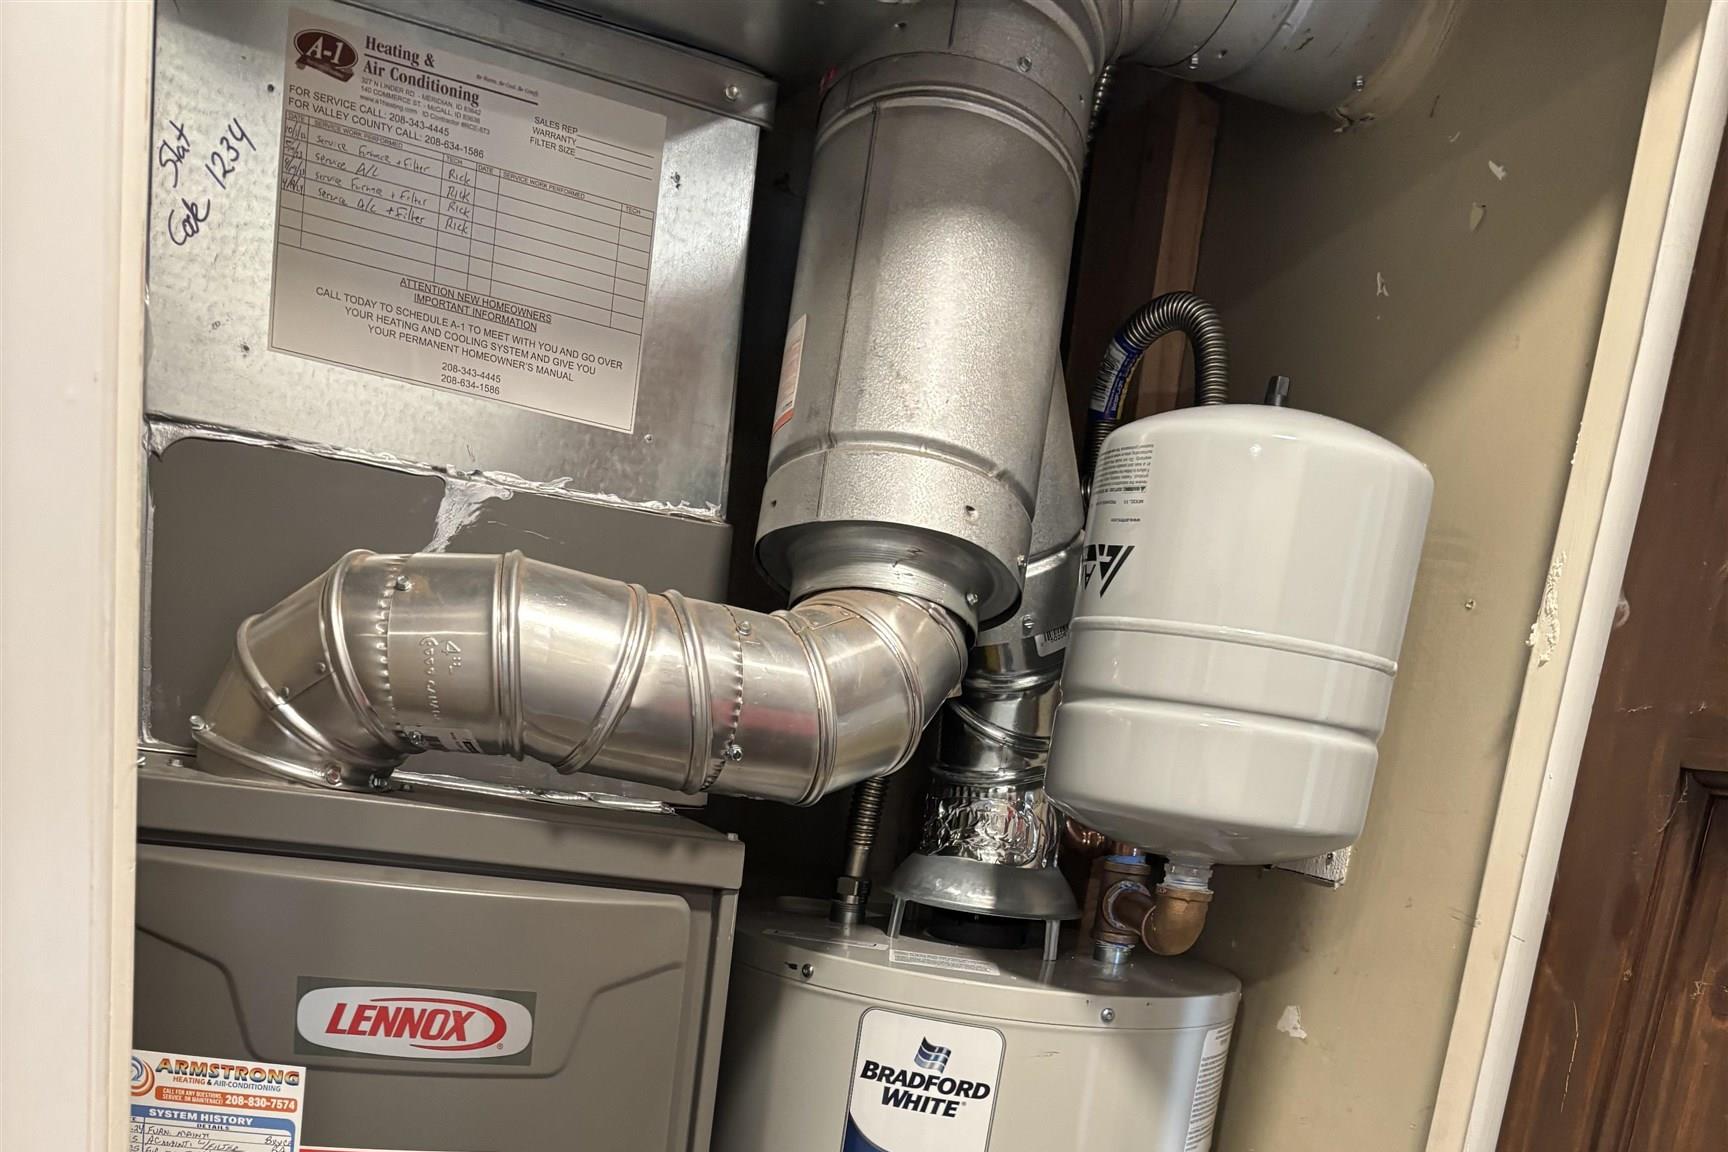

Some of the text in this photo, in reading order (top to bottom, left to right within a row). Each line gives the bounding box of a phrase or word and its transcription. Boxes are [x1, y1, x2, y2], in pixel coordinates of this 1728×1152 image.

[307, 36, 343, 65] A-1
[365, 35, 436, 68] Heating &
[363, 60, 385, 78] Air
[390, 67, 479, 107] Conditioning
[289, 84, 311, 97] FOR
[313, 91, 356, 111] SERVICE
[389, 112, 450, 137] 208-343-4445
[534, 116, 578, 134] SALES REP
[288, 97, 310, 111] FOR
[312, 103, 350, 121] VALLEY
[351, 115, 394, 133] COUNTY
[424, 135, 485, 159] 208-634-1586
[532, 126, 577, 146] WARRANTY
[205, 118, 256, 189] 1234
[530, 136, 576, 156] FILTER SIZE
[478, 164, 494, 174] DATE
[503, 172, 585, 200] SERVICE WORK PERFORMED
[626, 206, 641, 215] TECH
[400, 277, 552, 323] ATTENTION NEW HOMEOWNERS
[414, 293, 537, 332] IMPORTANT INFORMATION
[316, 286, 623, 370] CALL TODAY TO SCHEDULE A-1 TO MEET WITH YOU AND GO OVER
[345, 306, 597, 375] YOUR HEATING AND COOLING SYSTEM AND GIVE YOU
[368, 325, 574, 382] YOUR PERMANENT HOMEOWNER'S MANUAL
[440, 373, 500, 395] 208-634-1586
[441, 361, 501, 383] 208-343-4445
[325, 1002, 476, 1043] LENNOX
[155, 1057, 300, 1087] ARMSTRONG
[172, 1075, 205, 1085] HEATING
[213, 1080, 281, 1092] AIR-CONDITIONING
[859, 1059, 991, 1101] BRADFORD
[149, 1108, 253, 1126] SYSTEM HISTORY
[225, 1095, 295, 1110] 208-830-7574
[880, 1085, 958, 1119] WHITE
